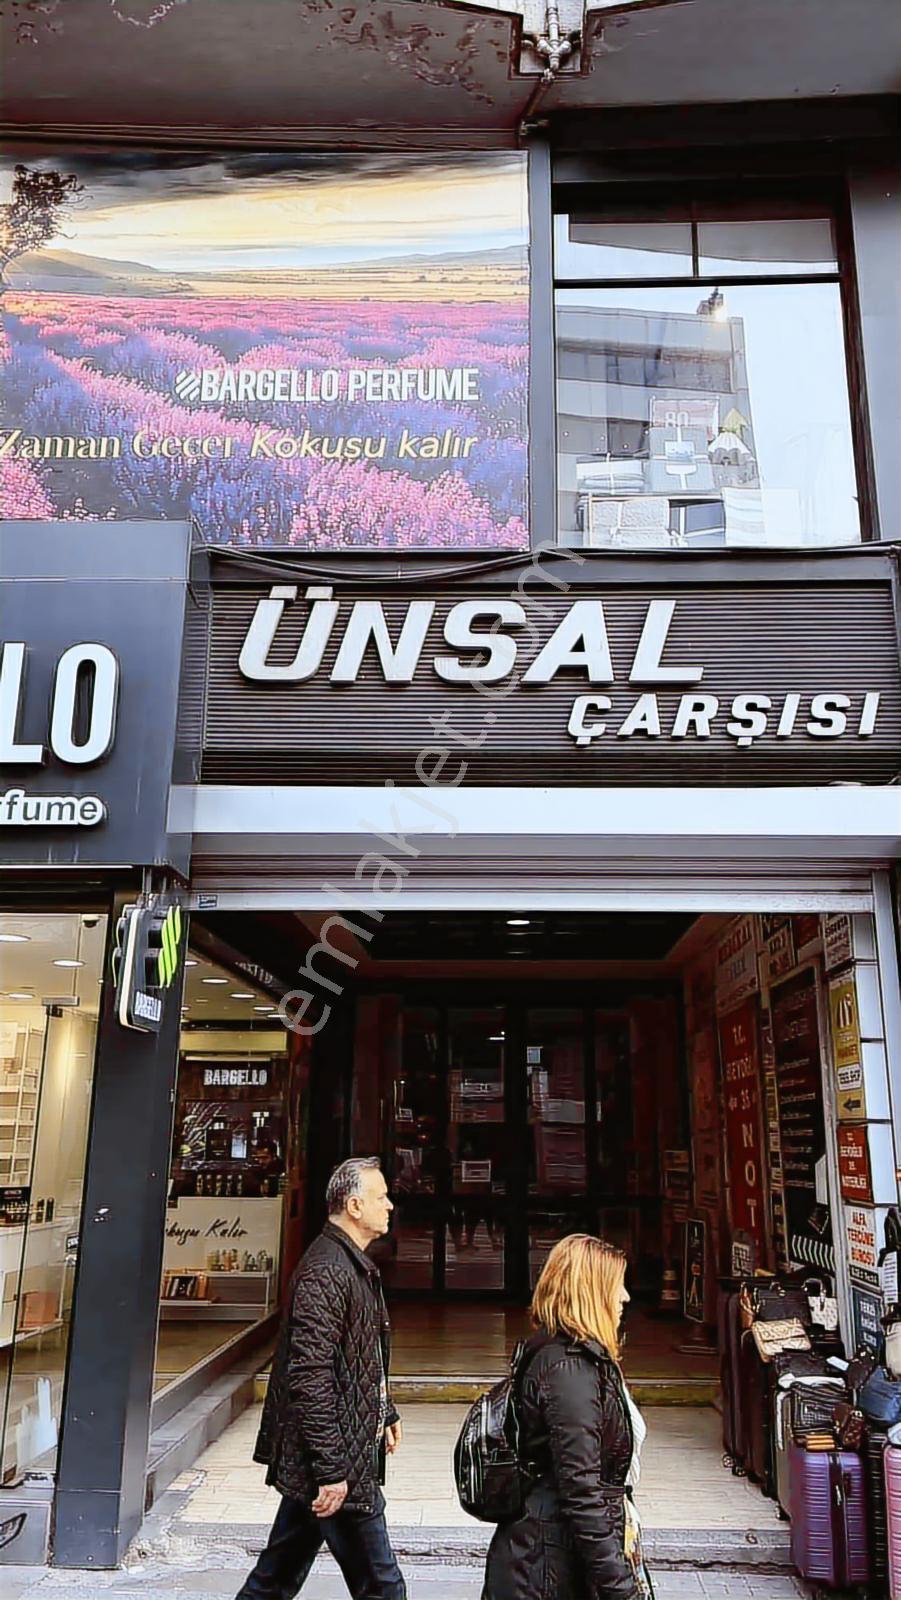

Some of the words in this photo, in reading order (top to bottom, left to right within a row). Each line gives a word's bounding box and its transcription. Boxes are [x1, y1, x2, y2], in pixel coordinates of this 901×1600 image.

[200, 368, 340, 403] BARGELLO
[348, 366, 480, 402] PERFUME
[0, 429, 121, 459] Zaman
[133, 430, 236, 464] Geçer
[250, 429, 387, 459] Kokusu
[399, 428, 478, 459] kalır
[237, 584, 705, 686] ÜNSAL
[566, 690, 882, 748] ÇARŞISI
[0, 794, 98, 821] fume
[203, 1069, 268, 1087] BARGELLO
